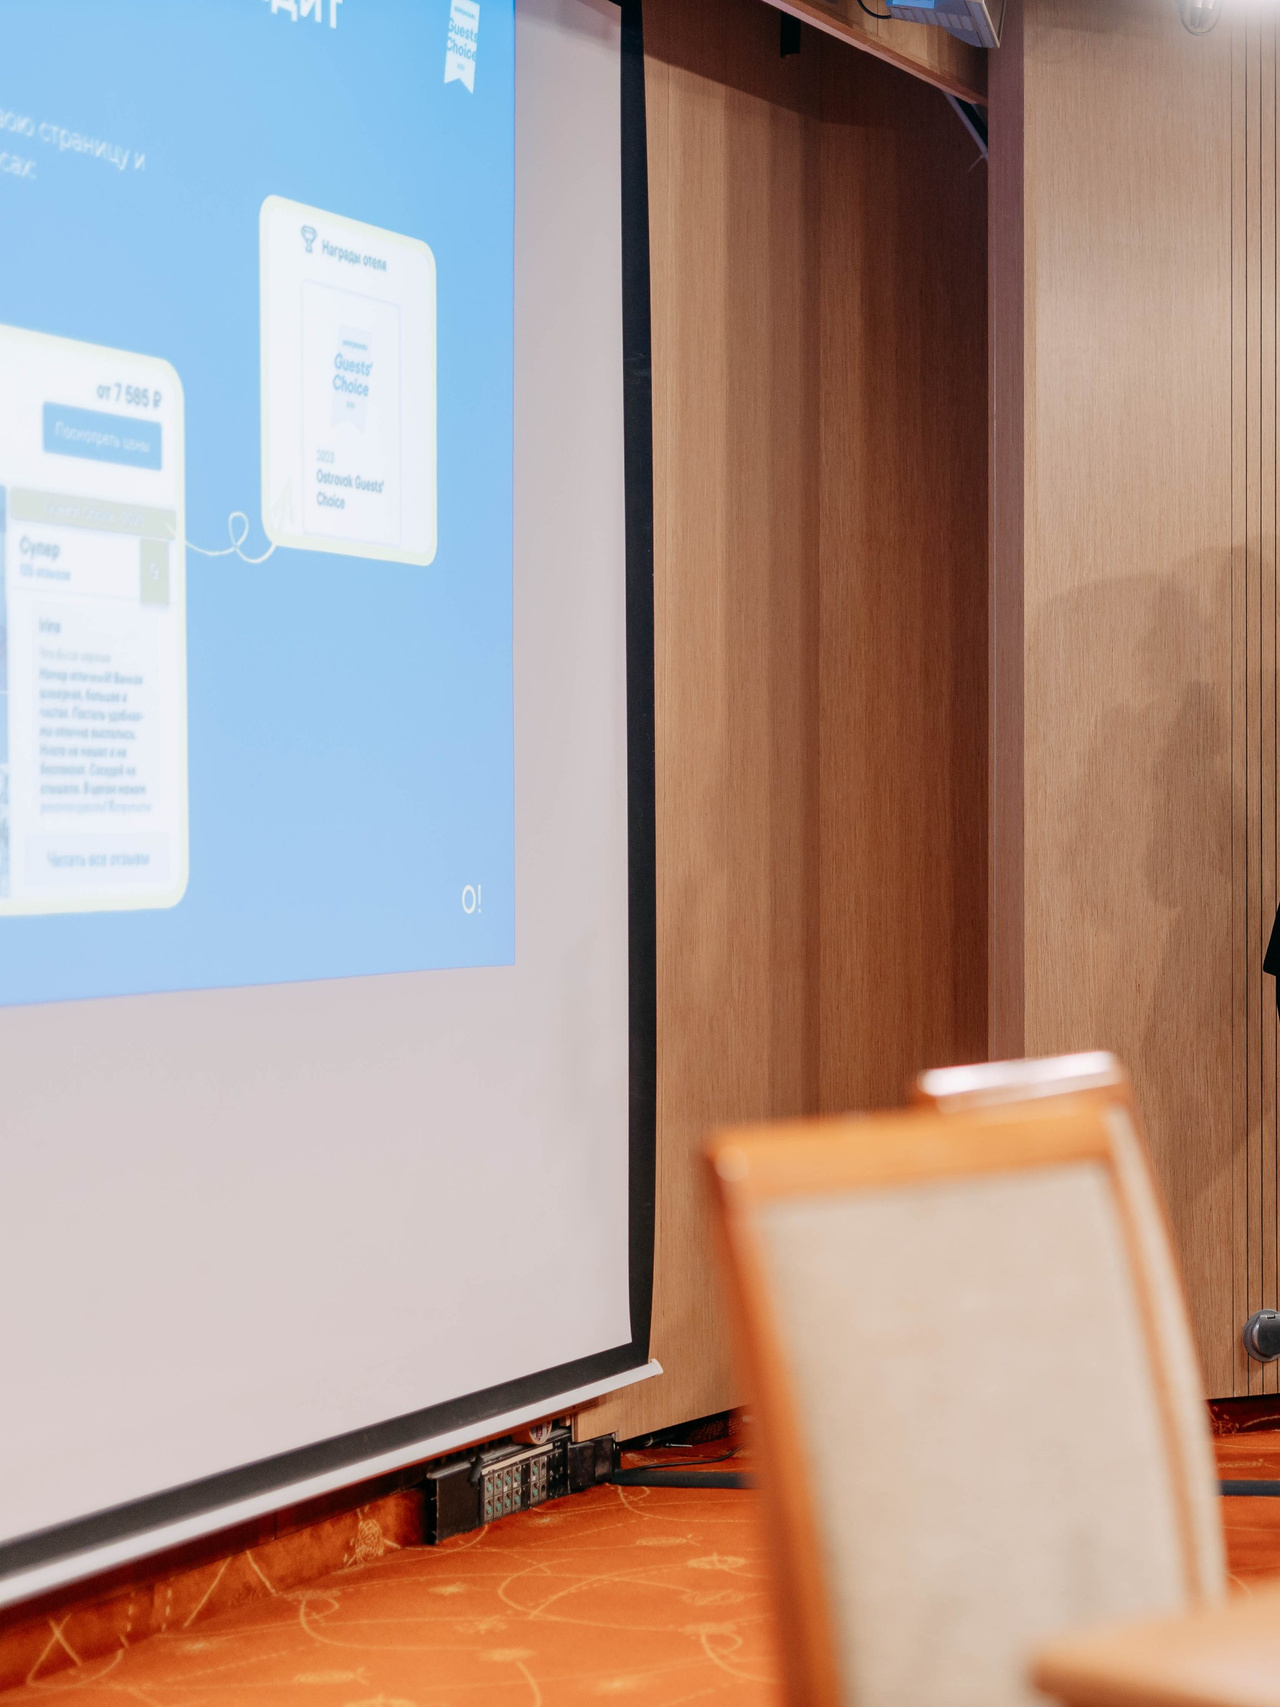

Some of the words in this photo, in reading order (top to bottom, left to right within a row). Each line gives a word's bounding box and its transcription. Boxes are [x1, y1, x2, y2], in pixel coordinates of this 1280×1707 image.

[264, 0, 344, 30] дит
[446, 37, 478, 62] Choice
[38, 121, 131, 171] страницу
[134, 151, 147, 172] и
[322, 239, 362, 265] Награды
[363, 254, 388, 273] отеля
[97, 384, 112, 400] от
[114, 382, 122, 402] 7
[332, 374, 370, 398] Choice
[316, 468, 354, 489] Ostrovok
[316, 491, 346, 510] Choice
[20, 535, 61, 562] Супер
